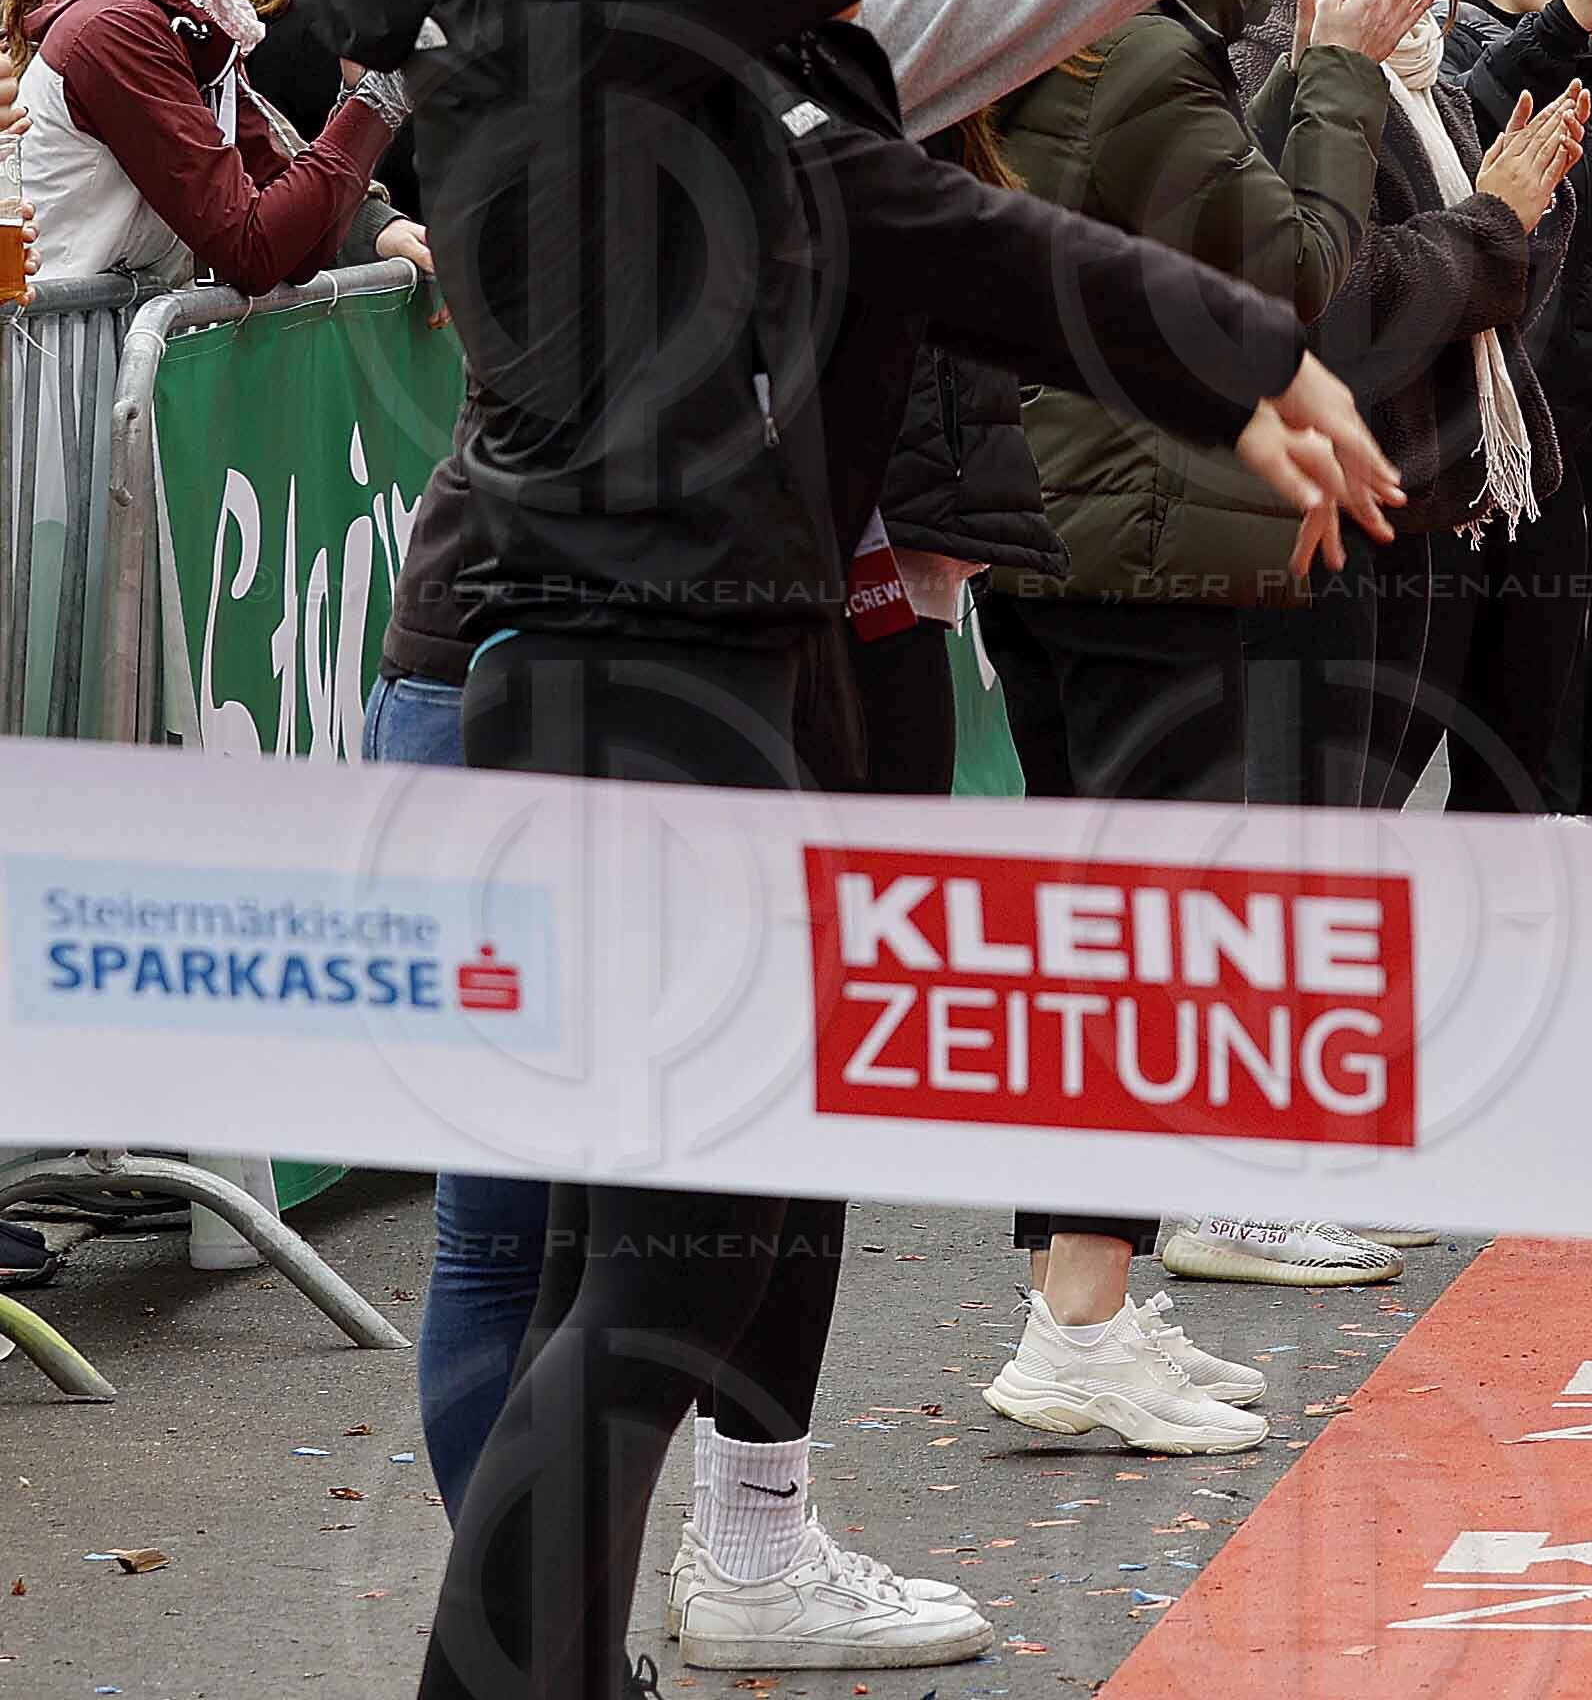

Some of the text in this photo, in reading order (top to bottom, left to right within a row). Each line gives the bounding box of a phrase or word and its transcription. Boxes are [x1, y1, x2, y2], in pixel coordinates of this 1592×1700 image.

[850, 579, 903, 614] CREW
[45, 886, 441, 946] Steiermärkische
[841, 871, 1385, 997] KLEINE
[47, 938, 441, 1010] SPARKASSE
[842, 982, 1387, 1115] ZEITUNG
